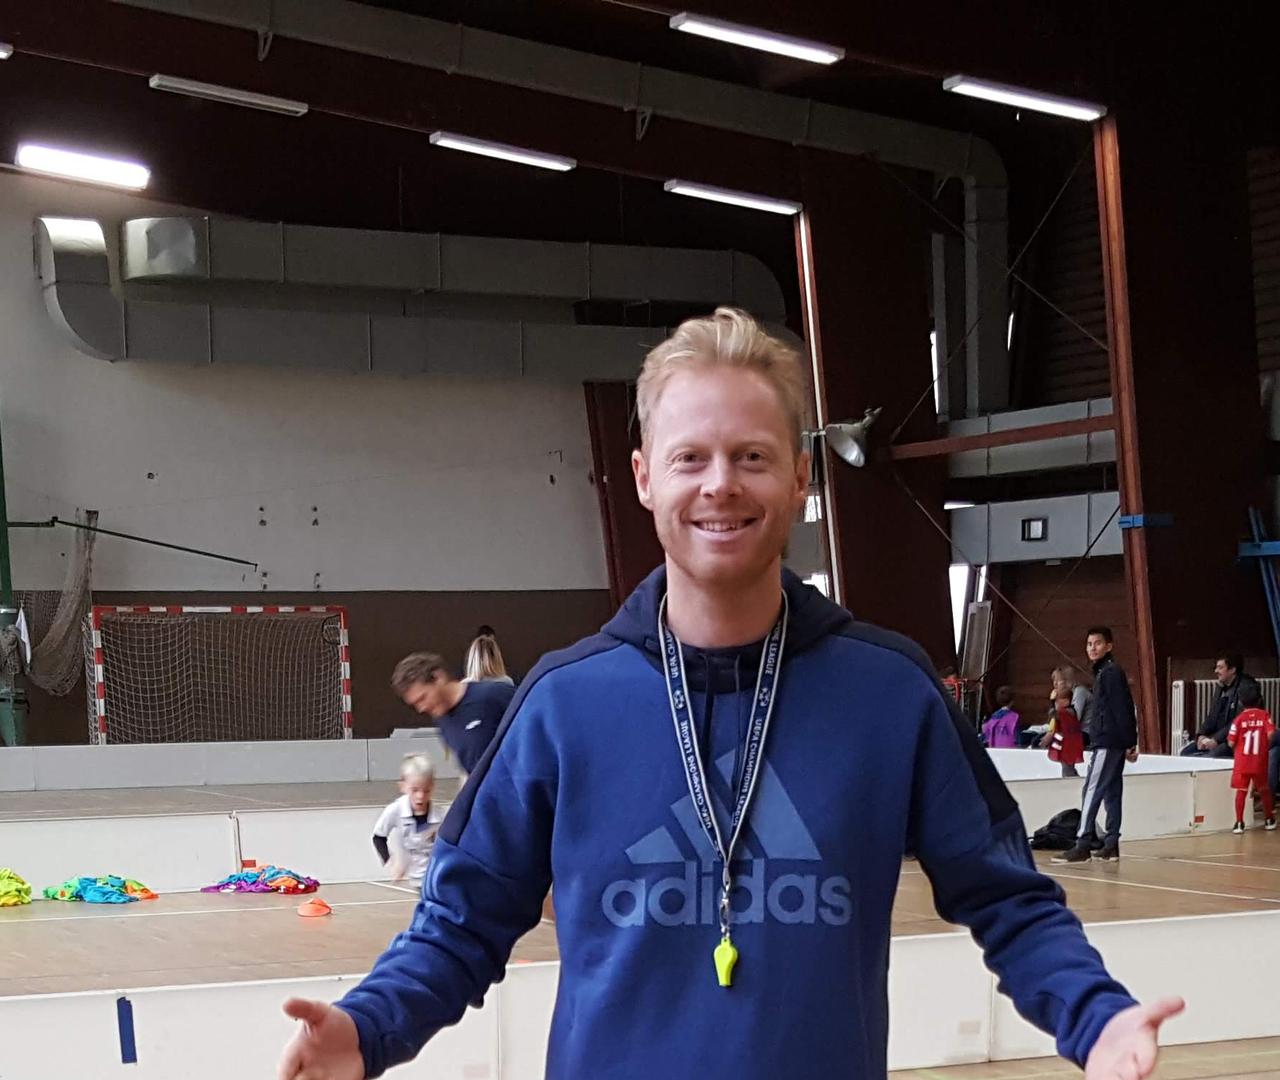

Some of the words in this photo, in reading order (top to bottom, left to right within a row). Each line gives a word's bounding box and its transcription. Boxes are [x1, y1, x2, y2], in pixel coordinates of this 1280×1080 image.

[680, 719, 694, 754] LEAGUE
[751, 718, 763, 741] UEFA
[1243, 730, 1260, 755] 11
[686, 755, 705, 806] CHAMPIONS
[740, 742, 758, 794] CHAMPIONS
[602, 858, 852, 928] adidas
